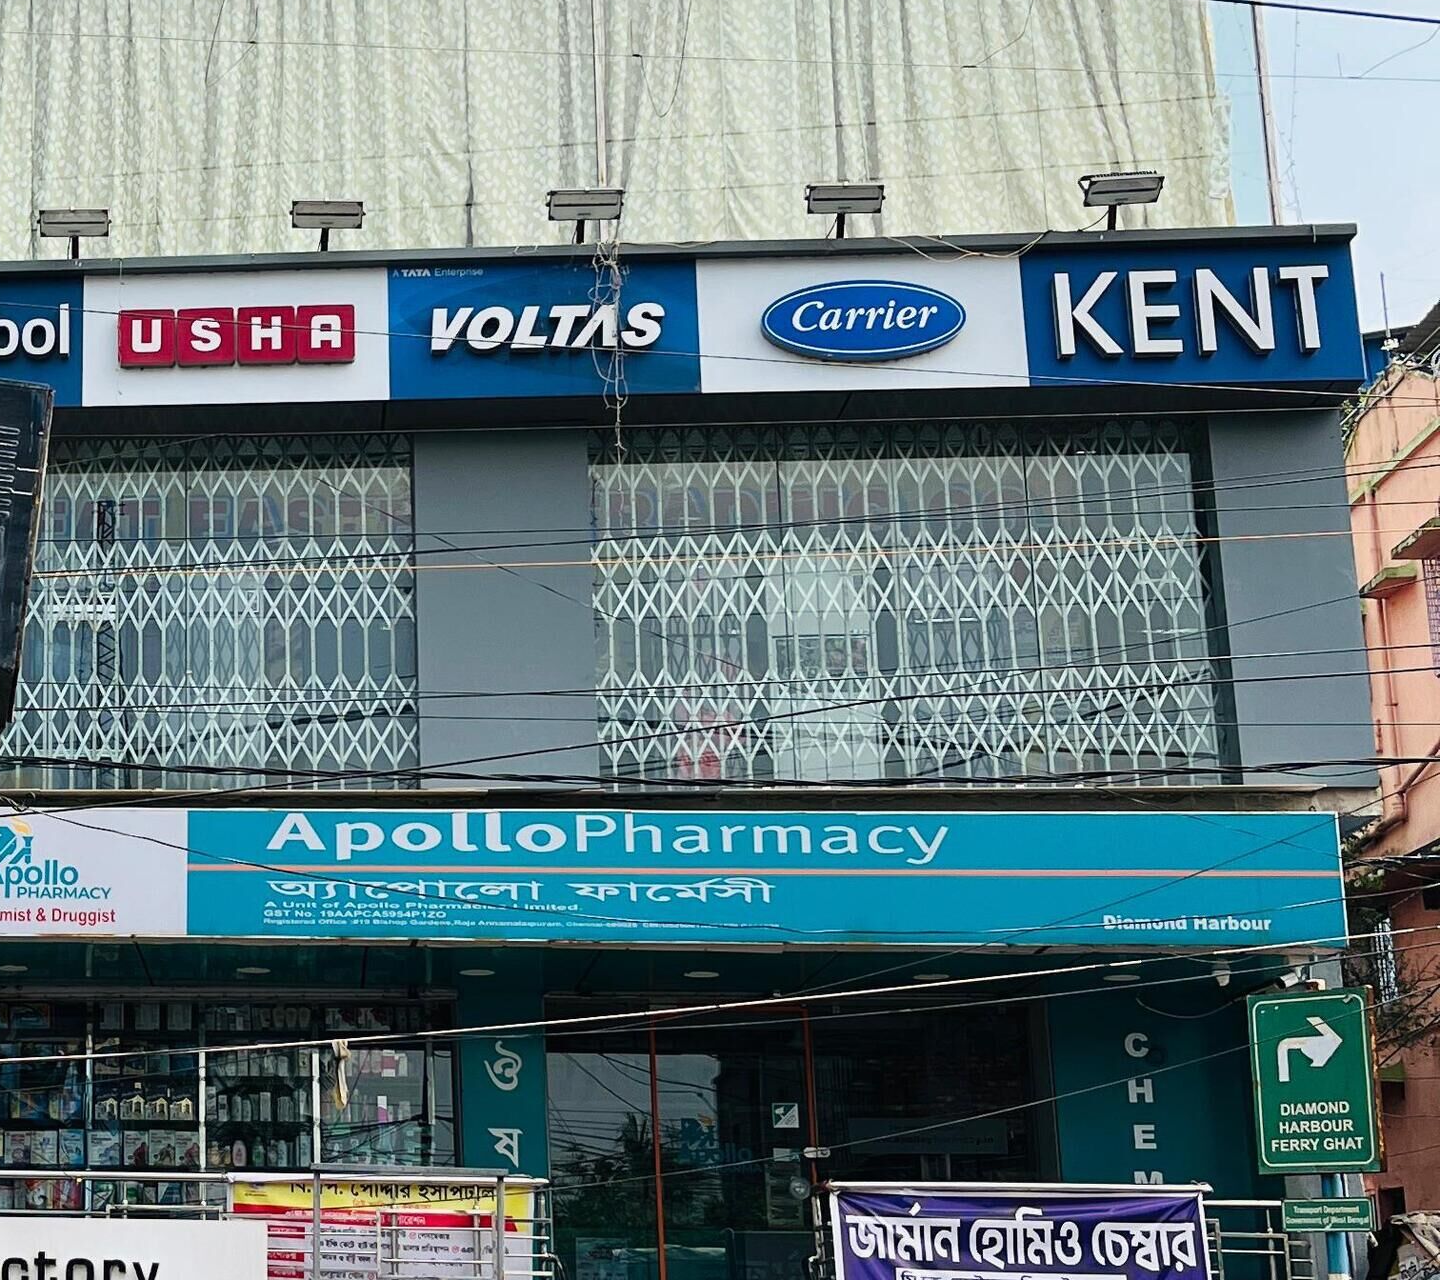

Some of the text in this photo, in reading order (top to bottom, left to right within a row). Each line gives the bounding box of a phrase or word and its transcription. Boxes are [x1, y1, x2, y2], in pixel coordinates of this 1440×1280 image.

[401, 268, 431, 278] TATA
[789, 296, 939, 337] Carrier
[1051, 265, 1331, 360] KENT
[126, 310, 346, 359] USHA
[429, 300, 663, 354] VOLTAS
[17, 887, 112, 900] PHARMACY
[266, 879, 544, 901] অ্যাপোলো
[263, 909, 294, 918] GST
[283, 901, 317, 909] Unit
[322, 901, 340, 909] of
[346, 901, 400, 910] Apollo
[36, 908, 46, 922] &
[51, 908, 116, 927] Druggist
[1103, 914, 1271, 932] Diamond Harbour
[1280, 1101, 1350, 1116] DIAMOND
[1279, 1120, 1354, 1134] HARBOUR
[1271, 1136, 1364, 1152] FERRY GHAT
[846, 1202, 1197, 1272] জার্মান হোমিও চেম্বার
